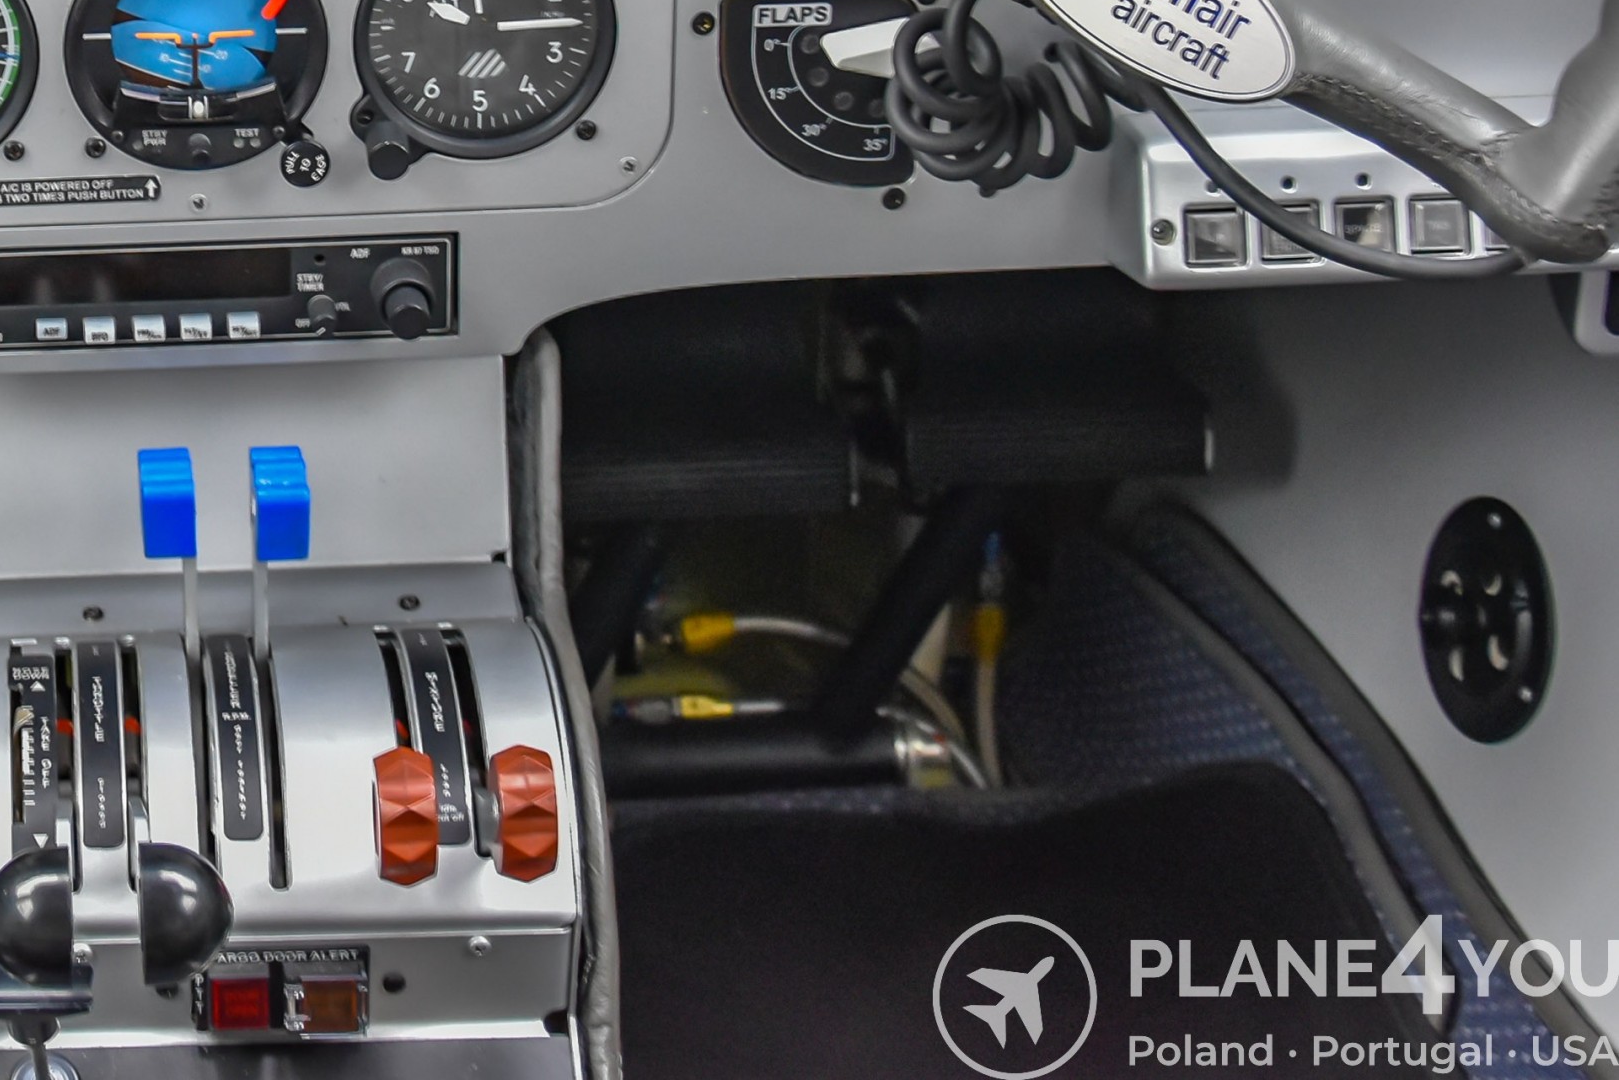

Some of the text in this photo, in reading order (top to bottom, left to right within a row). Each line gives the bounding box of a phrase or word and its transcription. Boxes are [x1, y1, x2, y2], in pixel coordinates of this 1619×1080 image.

[758, 6, 828, 24] FLAPS
[235, 129, 260, 137] TEST
[0, 183, 19, 193] A/C
[21, 183, 32, 192] IS
[35, 181, 90, 192] POWERED
[92, 180, 113, 189] OFF
[4, 194, 30, 203] TWO
[33, 193, 65, 202] TIMES
[68, 192, 97, 201] PUSH
[100, 189, 143, 200] BUTTON
[217, 949, 359, 963] ARGO DOOR ALERT
